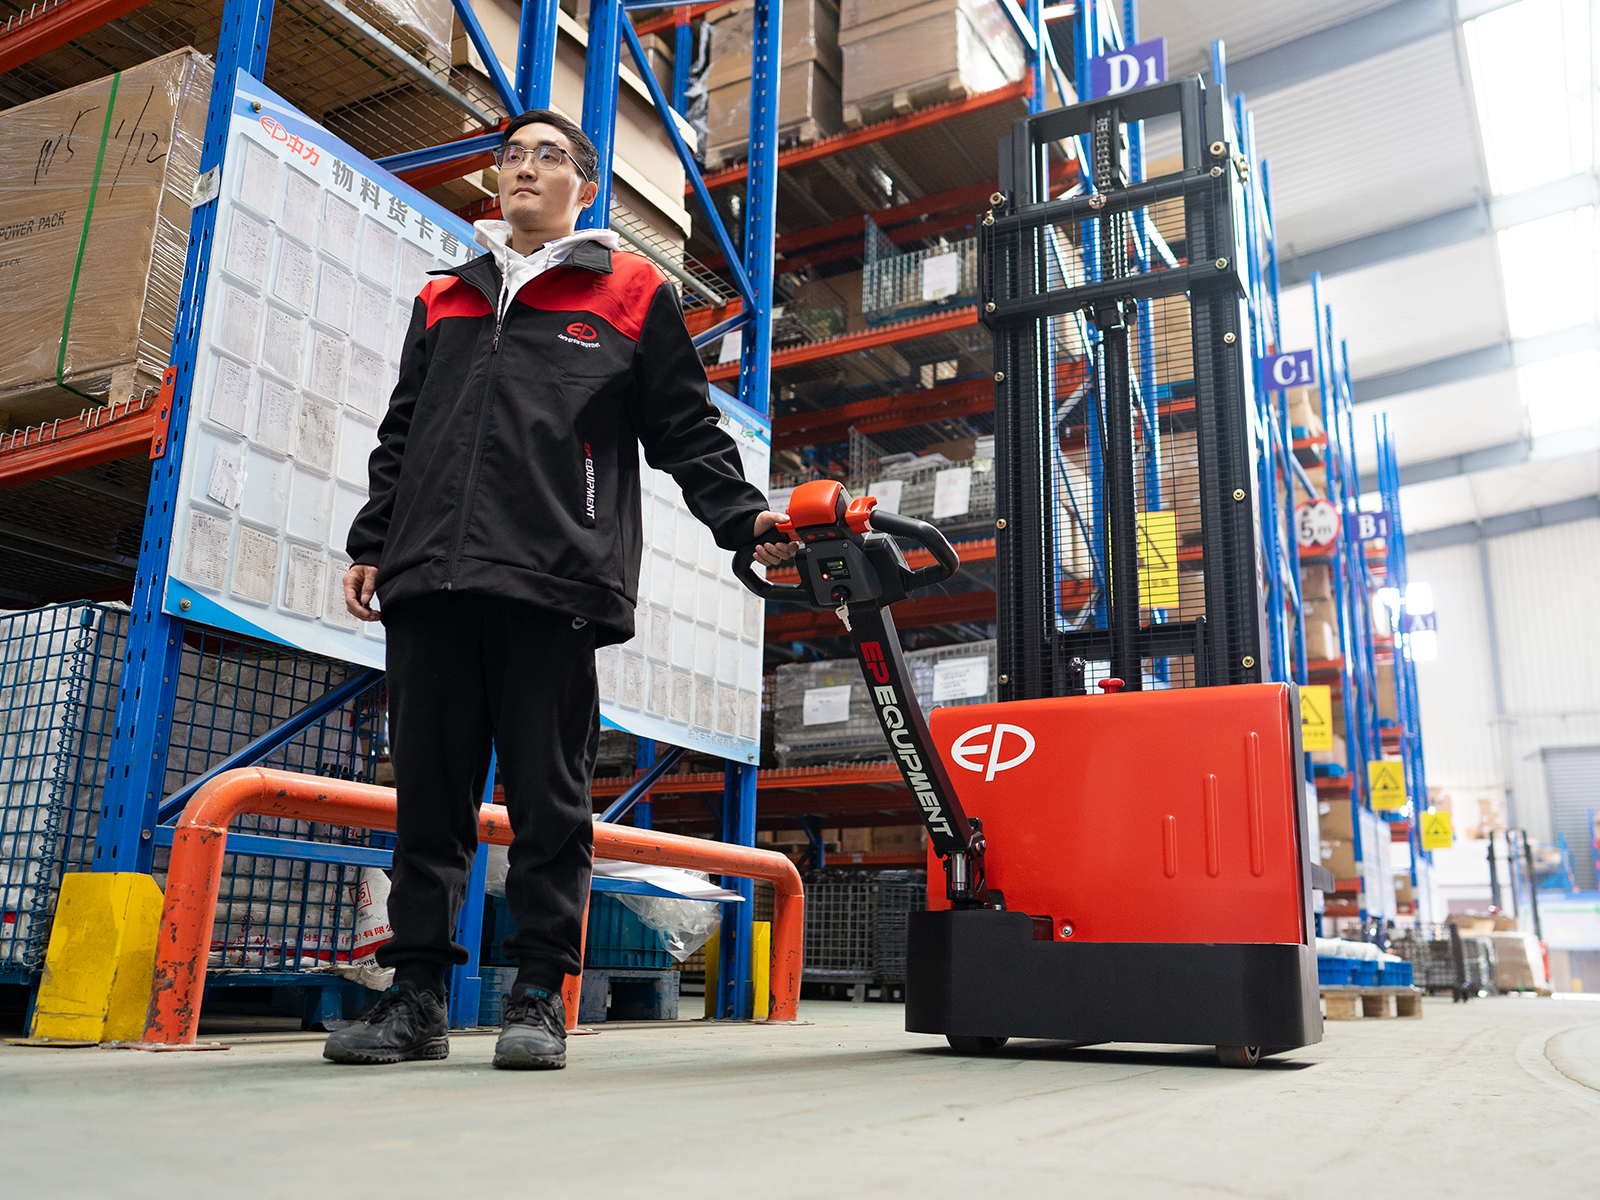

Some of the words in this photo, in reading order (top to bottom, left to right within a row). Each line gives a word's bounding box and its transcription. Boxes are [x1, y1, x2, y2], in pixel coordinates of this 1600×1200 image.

[1105, 53, 1161, 97] D1
[37, 210, 67, 232] PACK
[1273, 354, 1313, 386] C1
[584, 458, 596, 520] EQUIPMENT
[1357, 513, 1388, 541] B1
[859, 640, 890, 685] EP
[872, 684, 955, 839] EQUIPMENT
[950, 723, 1036, 782] EP
